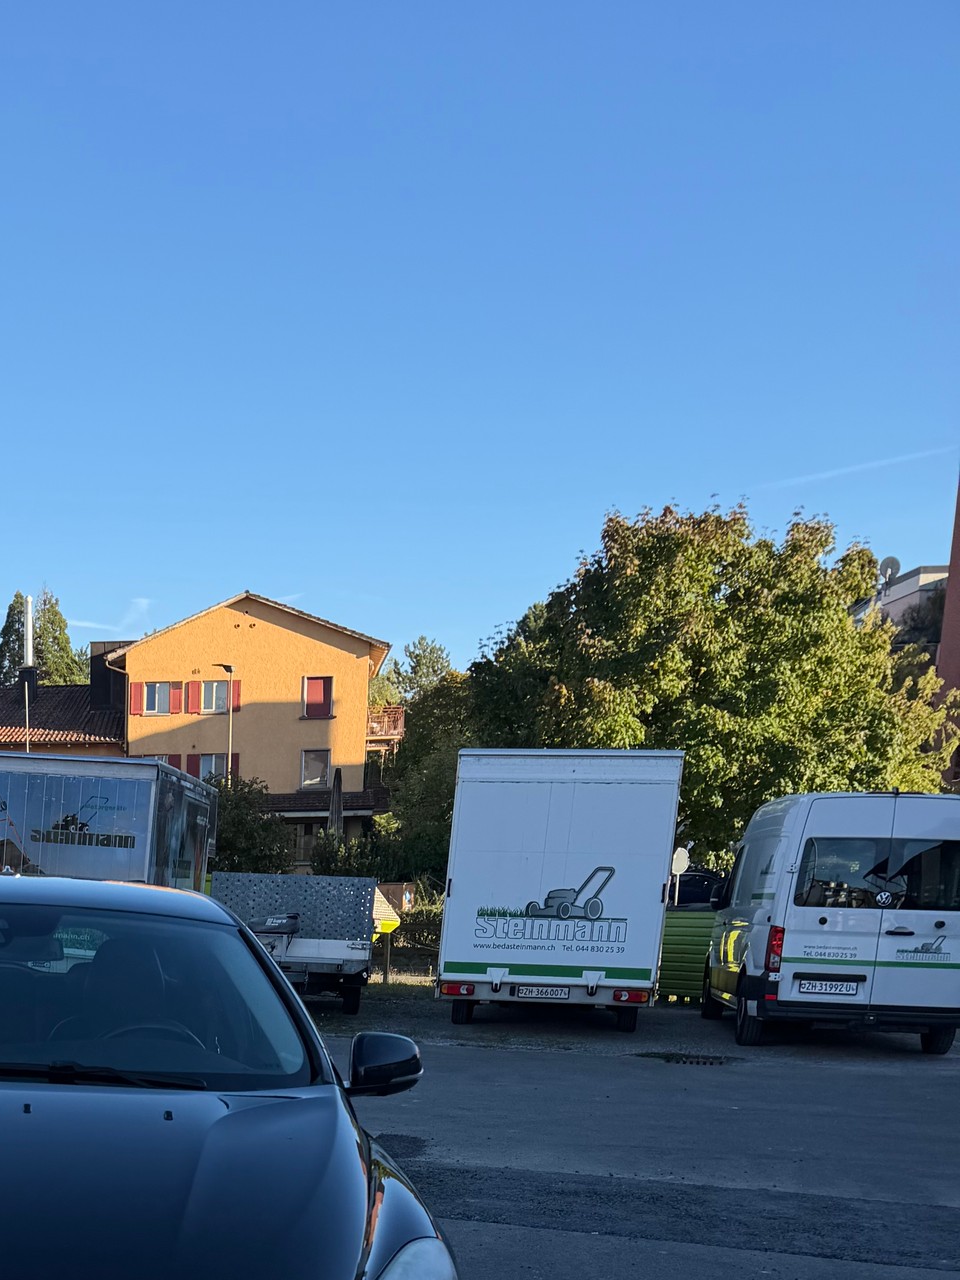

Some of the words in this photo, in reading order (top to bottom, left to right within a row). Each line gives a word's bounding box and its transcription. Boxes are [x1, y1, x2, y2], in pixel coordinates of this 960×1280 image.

[474, 916, 628, 943] Steinmann
[472, 942, 556, 951] www.bedasteinmann.ch
[575, 944, 589, 952] 044
[590, 945, 604, 953] 830
[615, 946, 625, 954] 39
